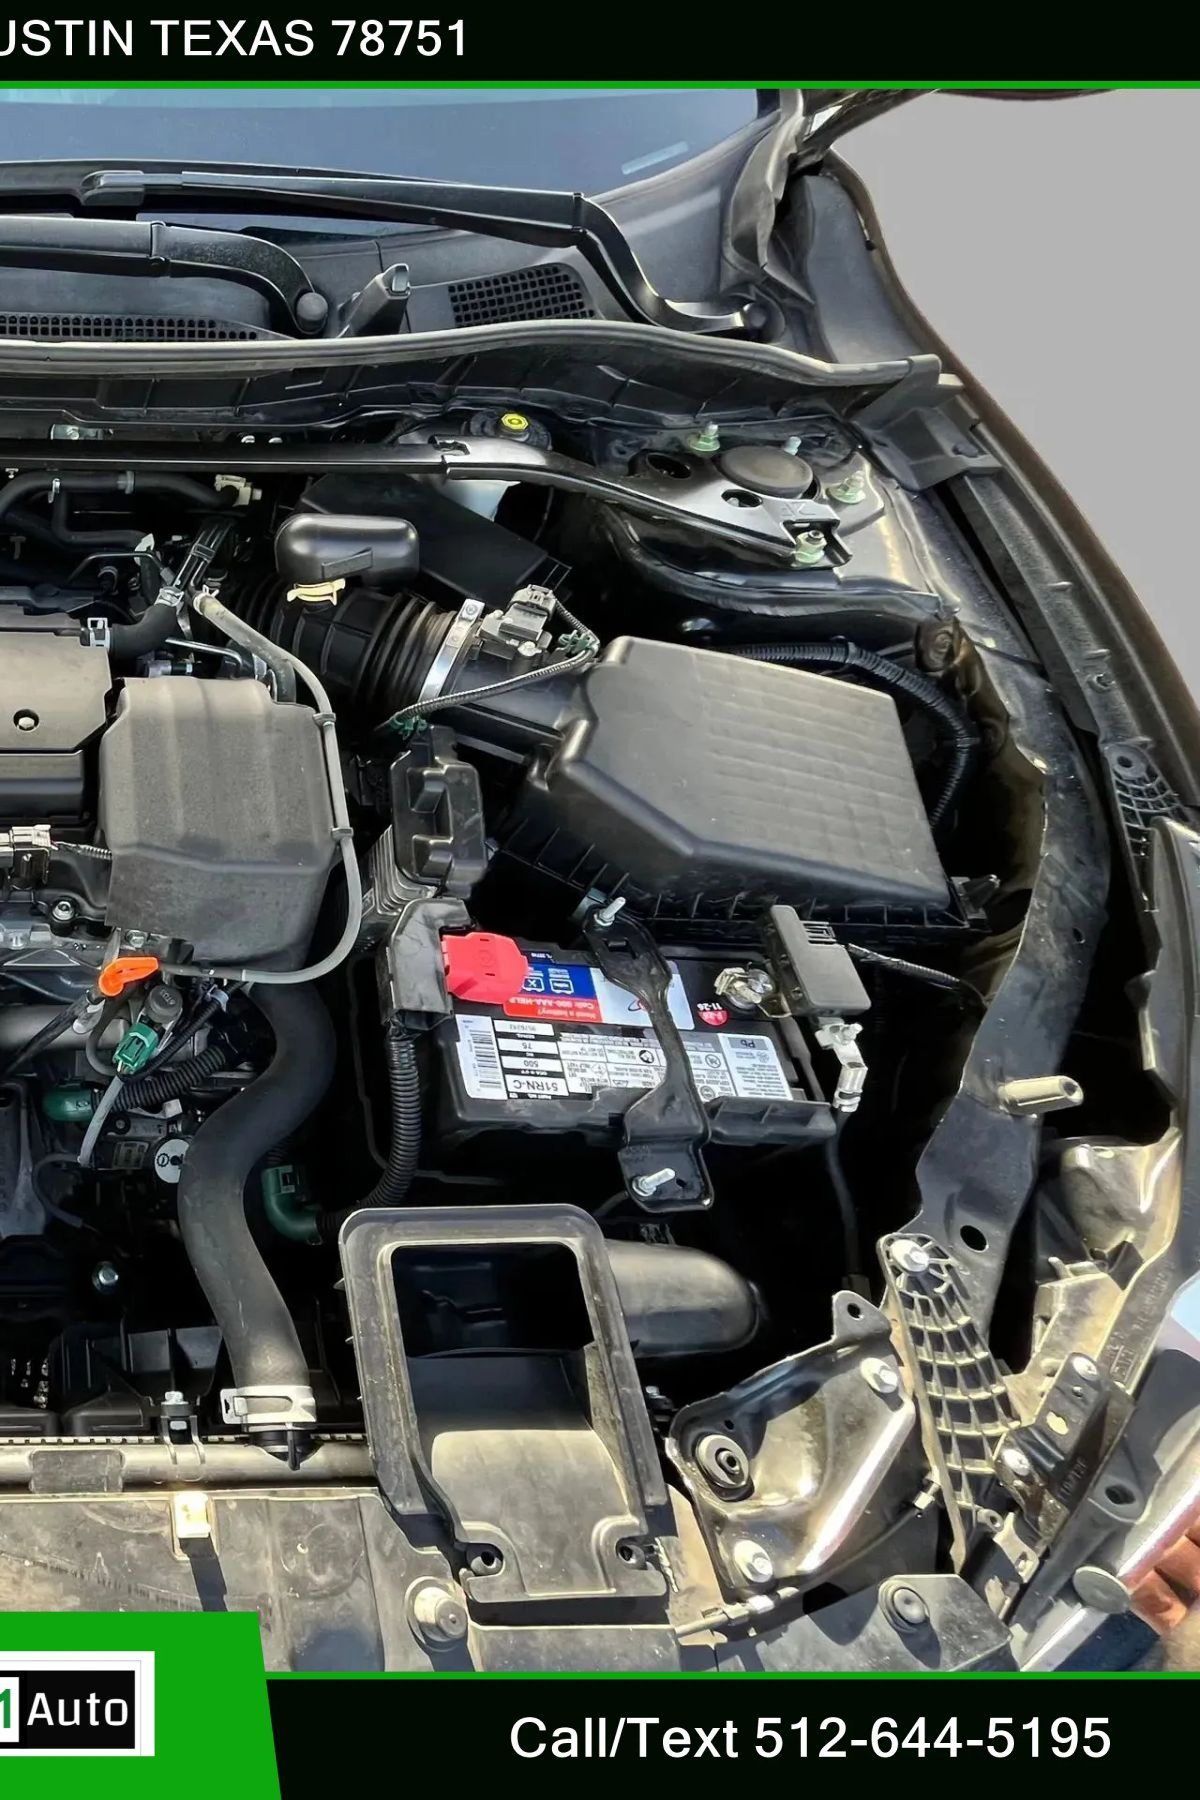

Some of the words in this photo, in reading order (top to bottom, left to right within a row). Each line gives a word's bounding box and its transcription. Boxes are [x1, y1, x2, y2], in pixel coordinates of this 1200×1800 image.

[522, 1042, 533, 1050] 75
[739, 1039, 756, 1049] Pb
[523, 1060, 539, 1068] 500
[512, 1079, 558, 1092] 51RN-C
